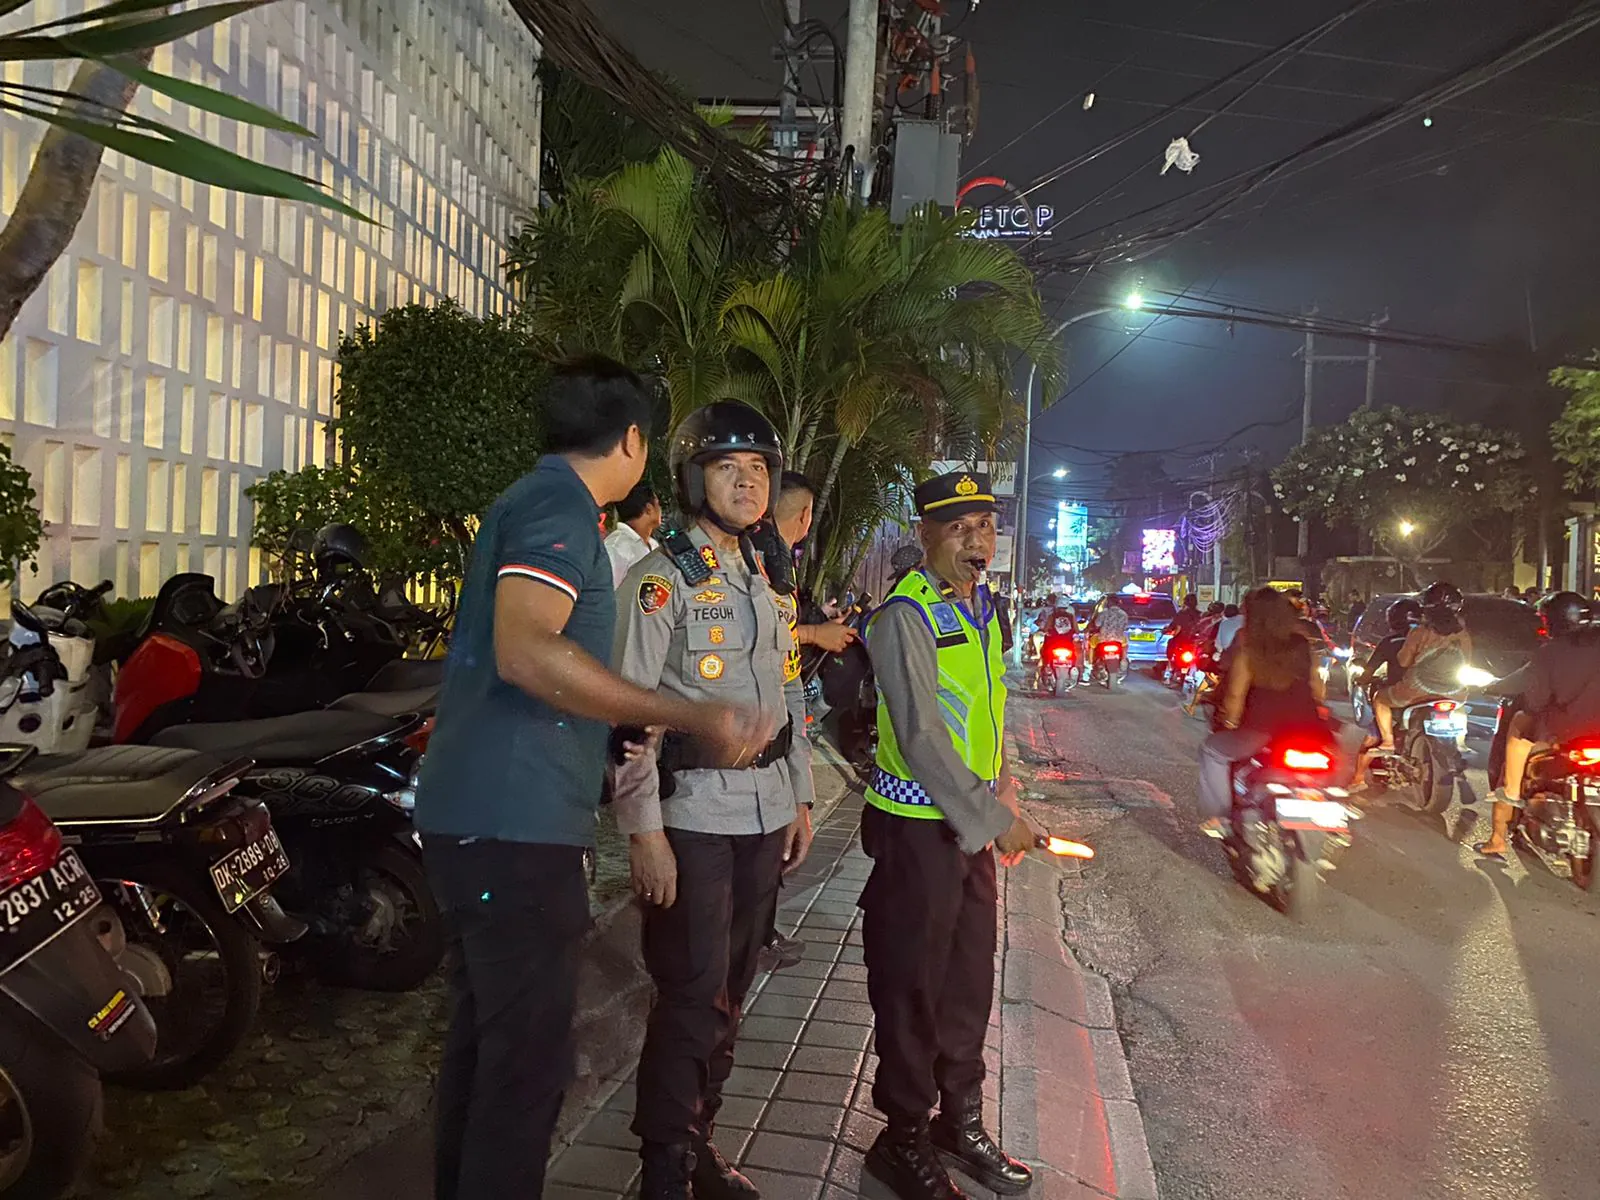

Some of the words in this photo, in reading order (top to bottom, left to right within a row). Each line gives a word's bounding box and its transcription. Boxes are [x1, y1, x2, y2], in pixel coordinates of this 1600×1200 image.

[693, 607, 735, 621] TEGUH
[214, 862, 235, 889] DK
[234, 841, 264, 875] 2889
[0, 876, 50, 925] 2837
[49, 854, 84, 890] ACR
